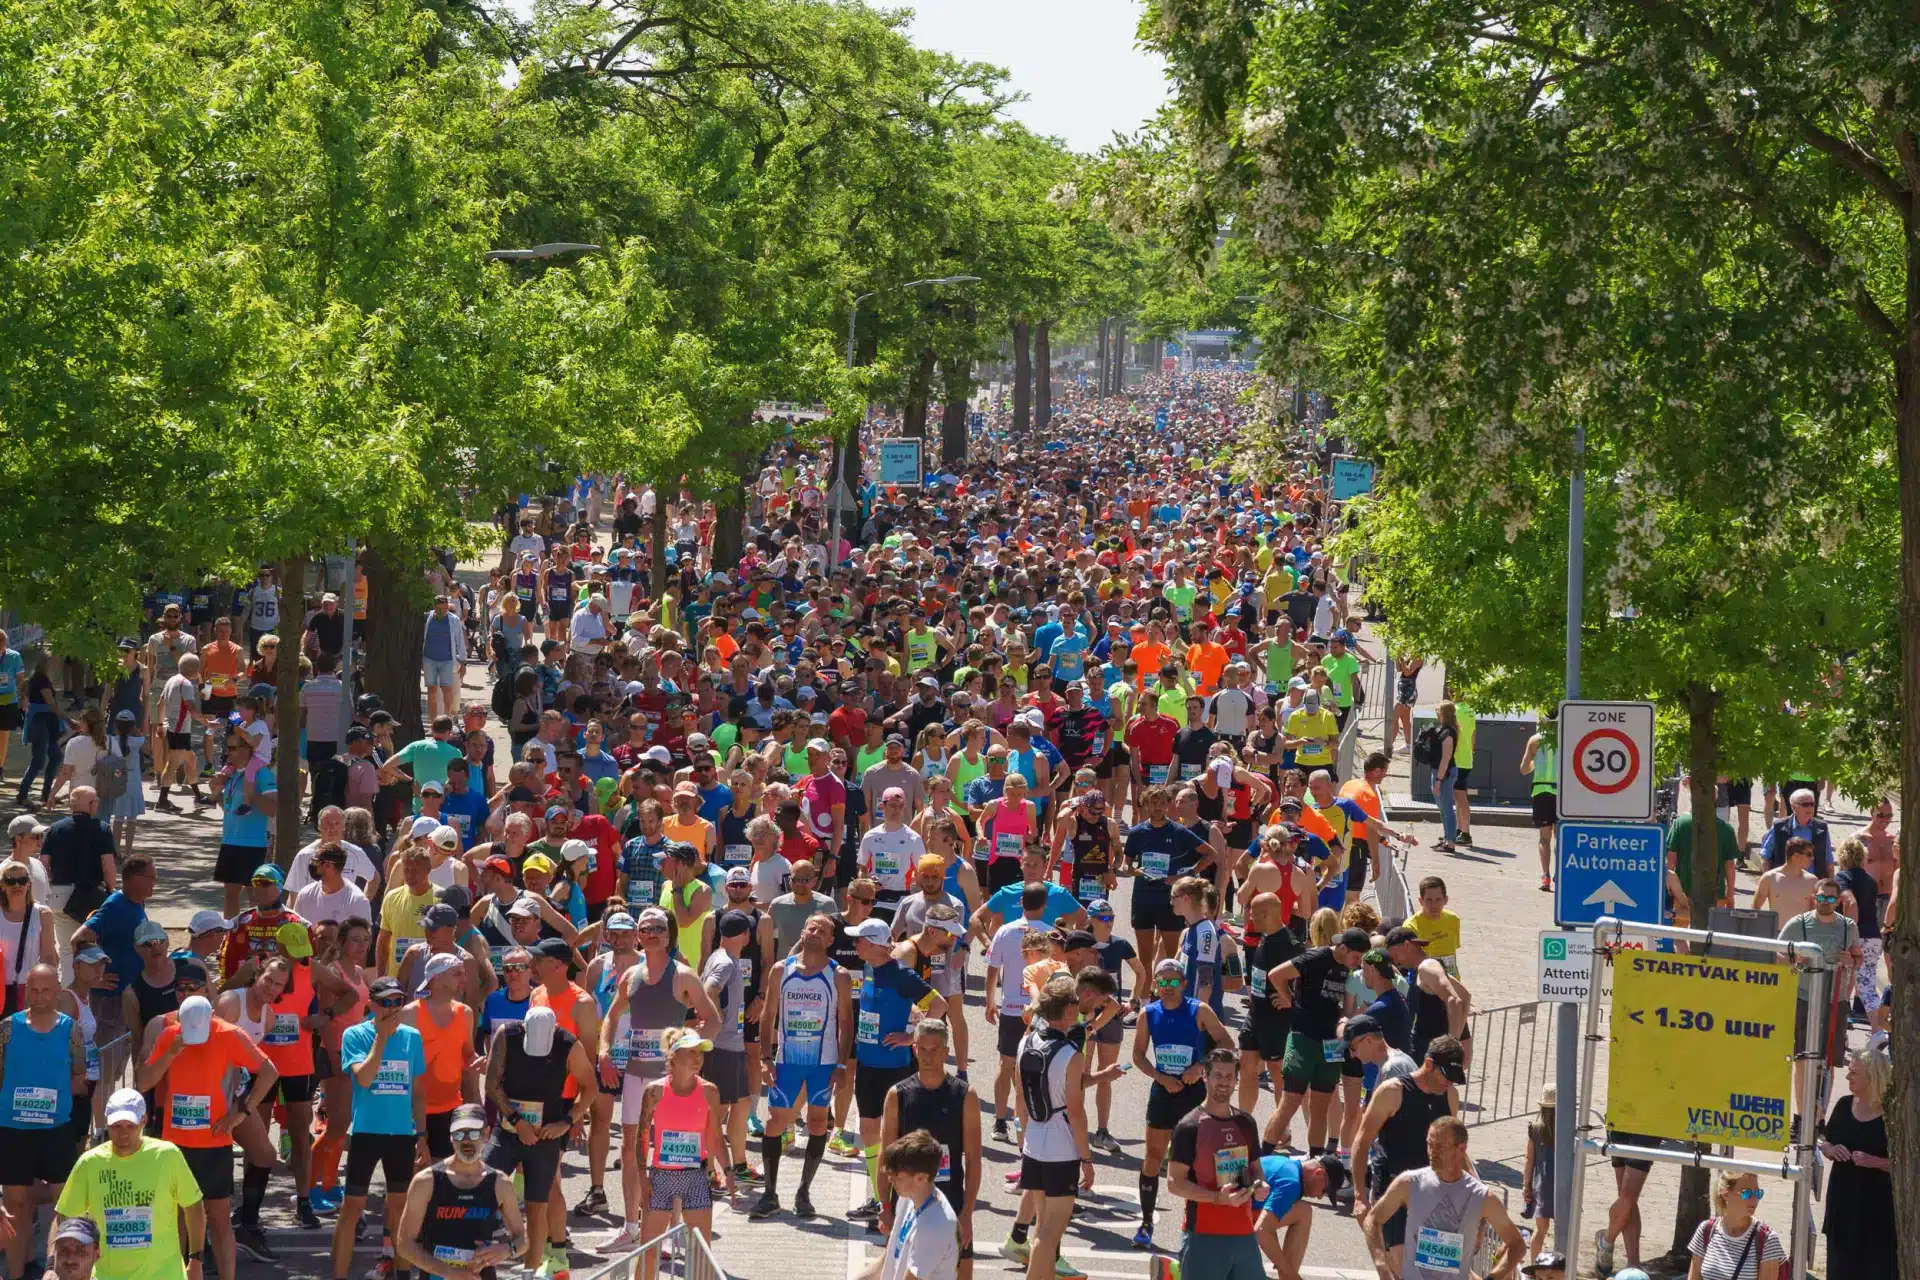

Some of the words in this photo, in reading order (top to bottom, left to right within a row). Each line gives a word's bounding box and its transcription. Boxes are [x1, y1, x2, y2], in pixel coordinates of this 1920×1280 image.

[1588, 712, 1627, 723] ZONE
[1586, 750, 1627, 773] 30
[1576, 832, 1648, 851] Parkeer
[1564, 853, 1656, 872] Automaat
[1543, 967, 1592, 980] Attenti
[1632, 957, 1740, 982] STARTVAK
[1745, 970, 1779, 987] HM
[787, 991, 823, 1001] ERDINGER
[1654, 1006, 1715, 1032] 1.30
[1725, 1018, 1776, 1040] uur
[1687, 1107, 1784, 1135] VENLOOP
[99, 1169, 117, 1184] WE
[110, 1180, 132, 1194] ARE
[103, 1190, 155, 1208] RUNNERS
[112, 1235, 146, 1243] Andrew
